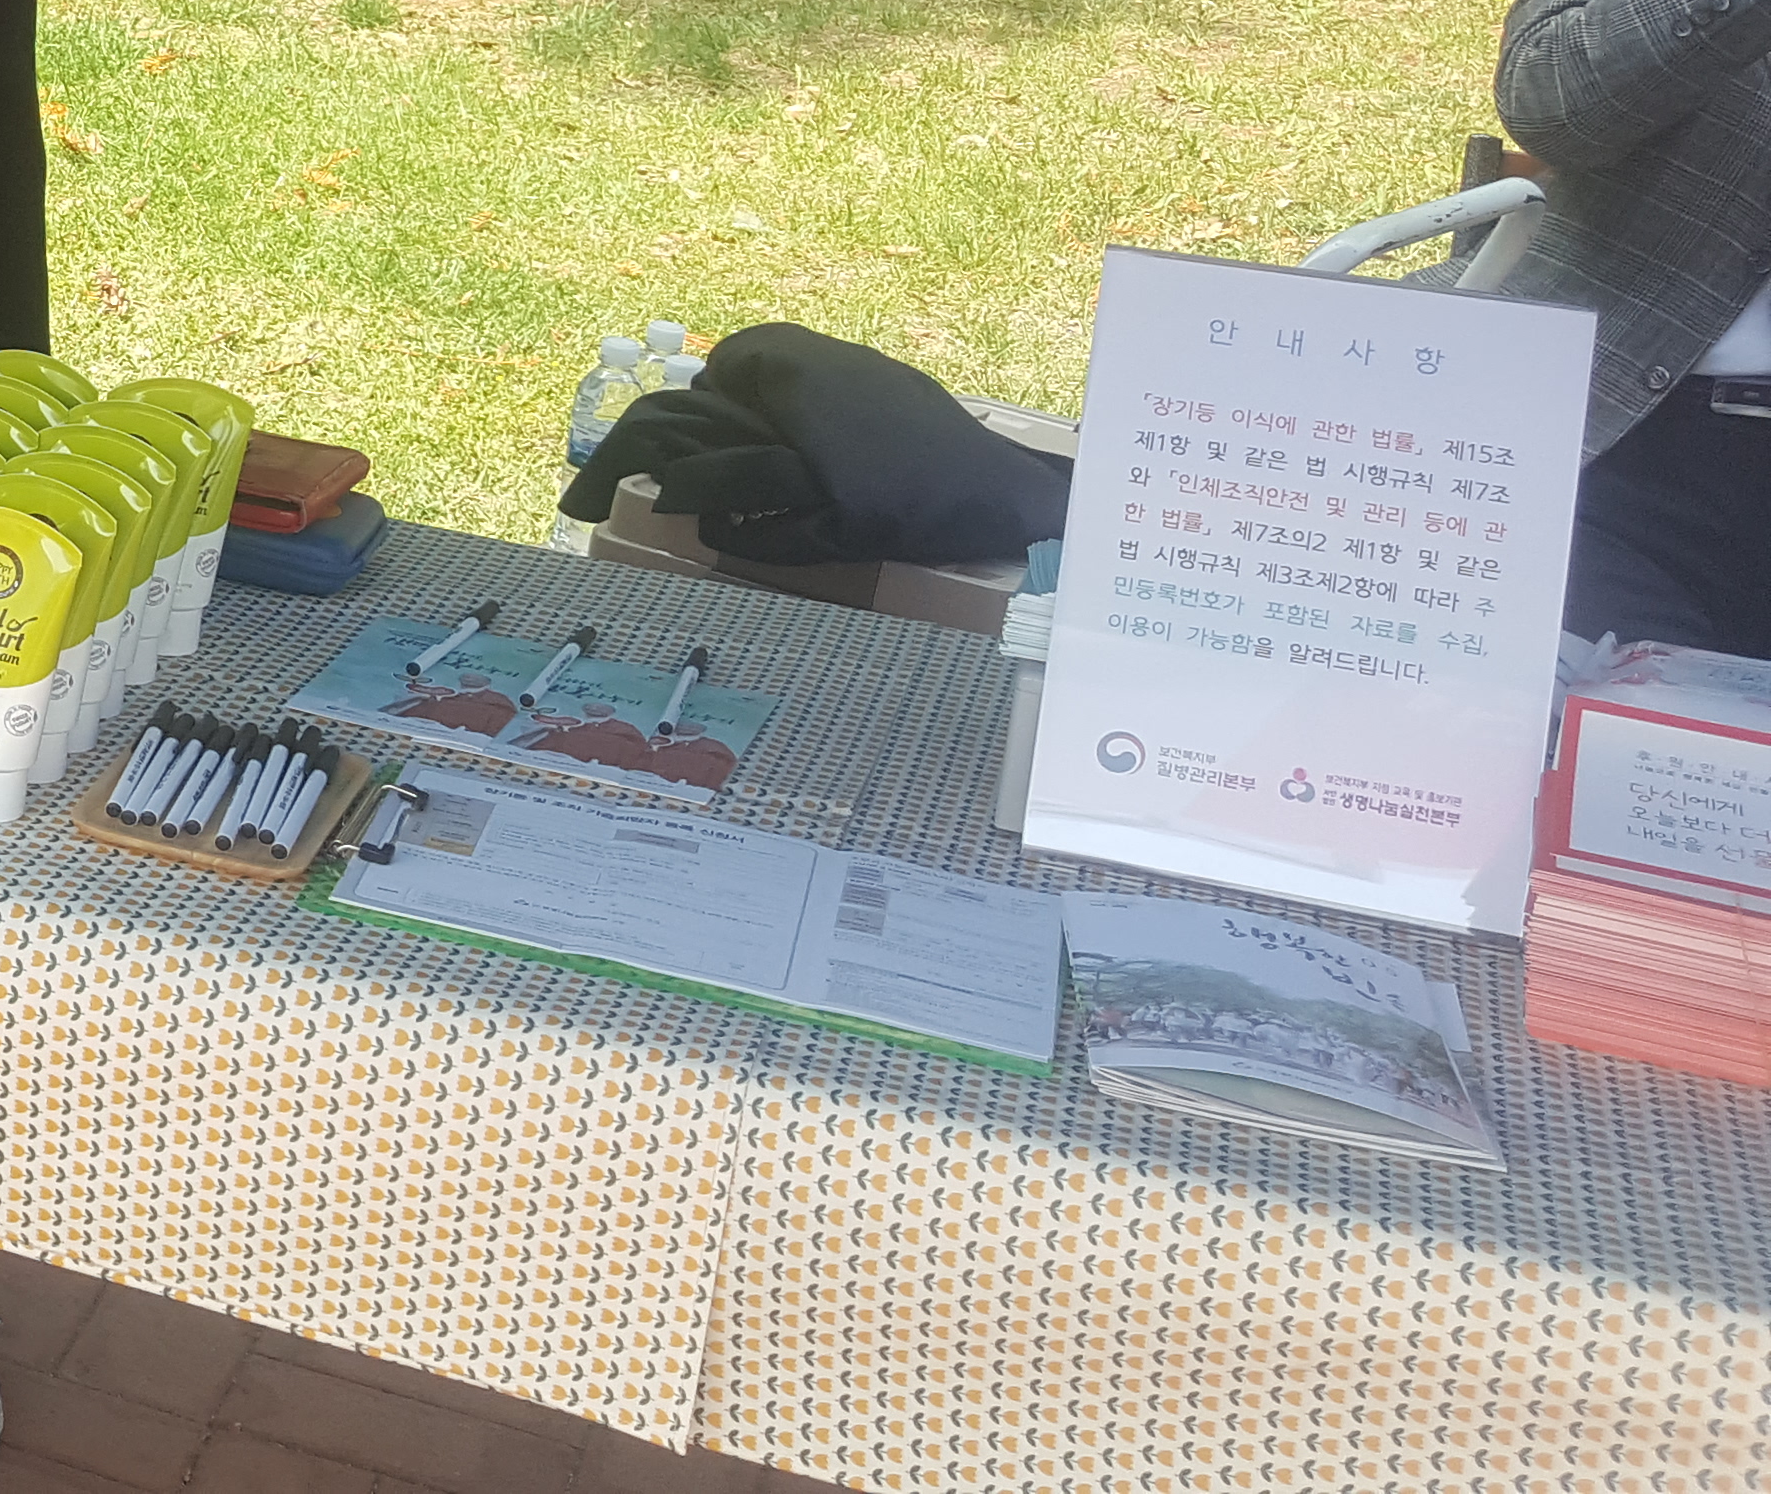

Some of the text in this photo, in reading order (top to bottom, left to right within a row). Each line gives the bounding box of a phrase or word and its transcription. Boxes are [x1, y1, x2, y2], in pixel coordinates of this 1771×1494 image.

[1232, 409, 1297, 436] 이식에
[1312, 419, 1357, 445] 관한
[1443, 439, 1516, 468] 제15조
[1134, 430, 1511, 505] 제1항 및 같은 법 시행규칙 제7조
[1129, 466, 1151, 487] 와
[1326, 497, 1347, 518] 및
[1363, 502, 1406, 528] 관리
[1423, 512, 1467, 538] 등에
[1484, 521, 1507, 543] 관
[1124, 502, 1146, 523] 한
[1232, 519, 1327, 552] 제7조의2
[1343, 538, 1402, 565] 제1항
[1418, 549, 1439, 571] 및
[1457, 555, 1501, 581] 같은
[1119, 539, 1496, 618] 법 시행규칙 제3조제2항에 따라 주
[1114, 575, 1245, 616] 민등록번호가
[1263, 600, 1329, 630] 포함된
[1351, 617, 1417, 645] 자료를
[1108, 614, 1172, 642] 이용이
[1186, 627, 1274, 659] 가능함을
[1156, 760, 1256, 793] 질병관리본부
[1159, 745, 1216, 766] 보건복지부
[1339, 791, 1461, 829] 생명나눔실천본부
[1629, 782, 1744, 816] 당신에게
[1629, 806, 1732, 834] 오늘보다
[1627, 825, 1708, 854] 내일을
